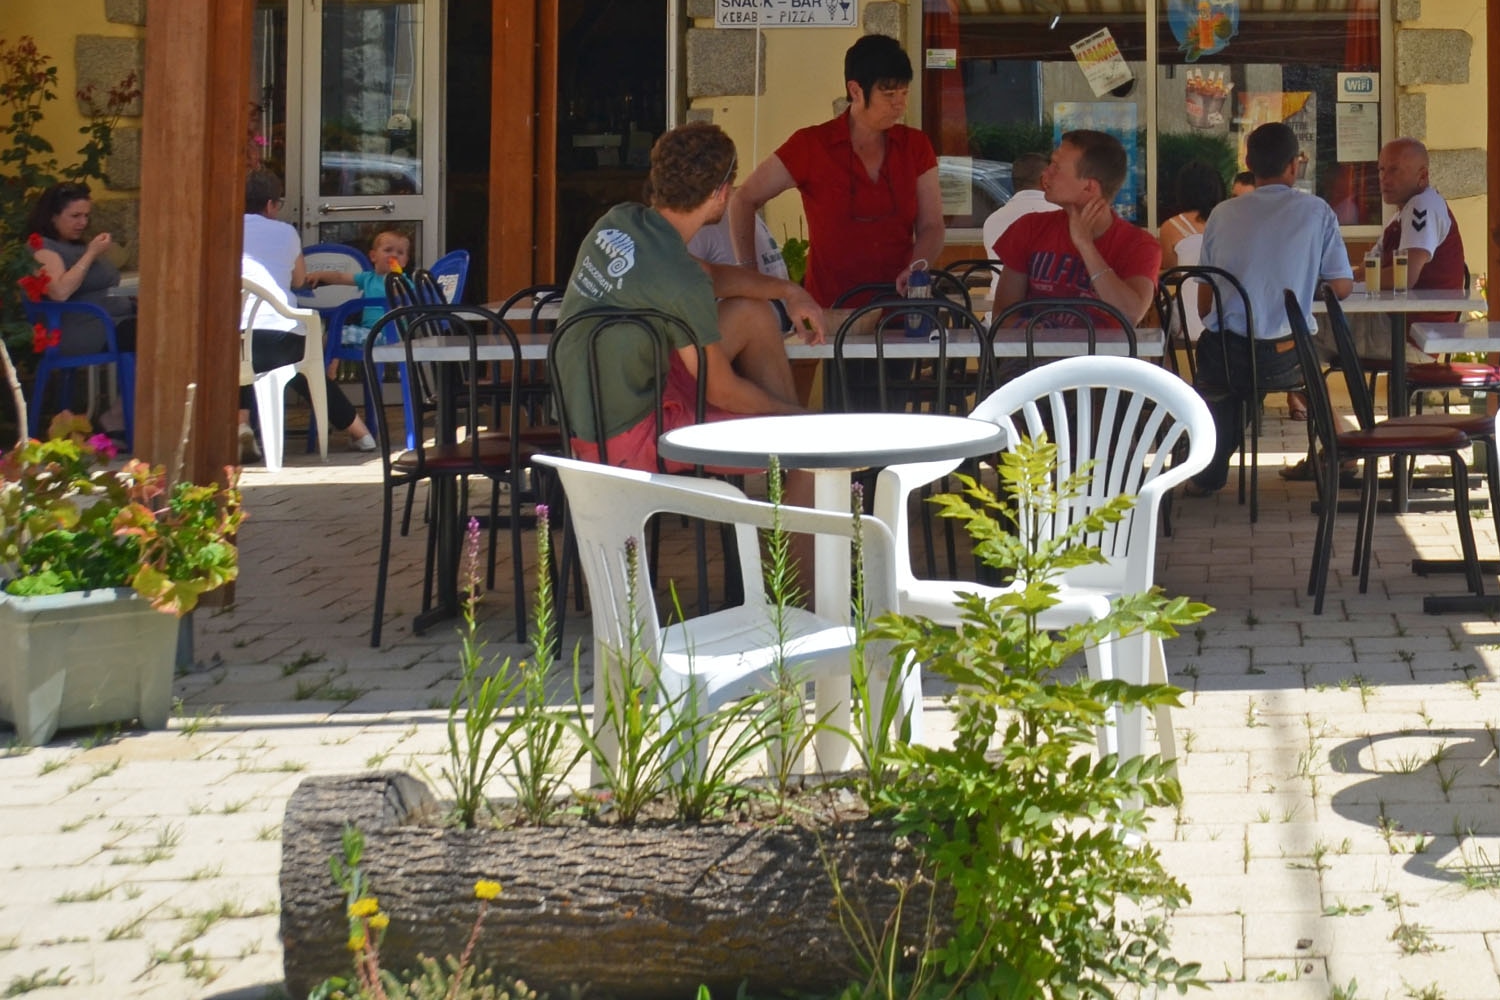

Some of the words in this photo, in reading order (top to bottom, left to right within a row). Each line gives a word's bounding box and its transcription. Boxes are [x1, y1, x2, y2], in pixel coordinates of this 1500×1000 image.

[721, 11, 759, 23] KEBAB
[779, 11, 816, 23] PIZZA
[1346, 78, 1370, 91] WiFi
